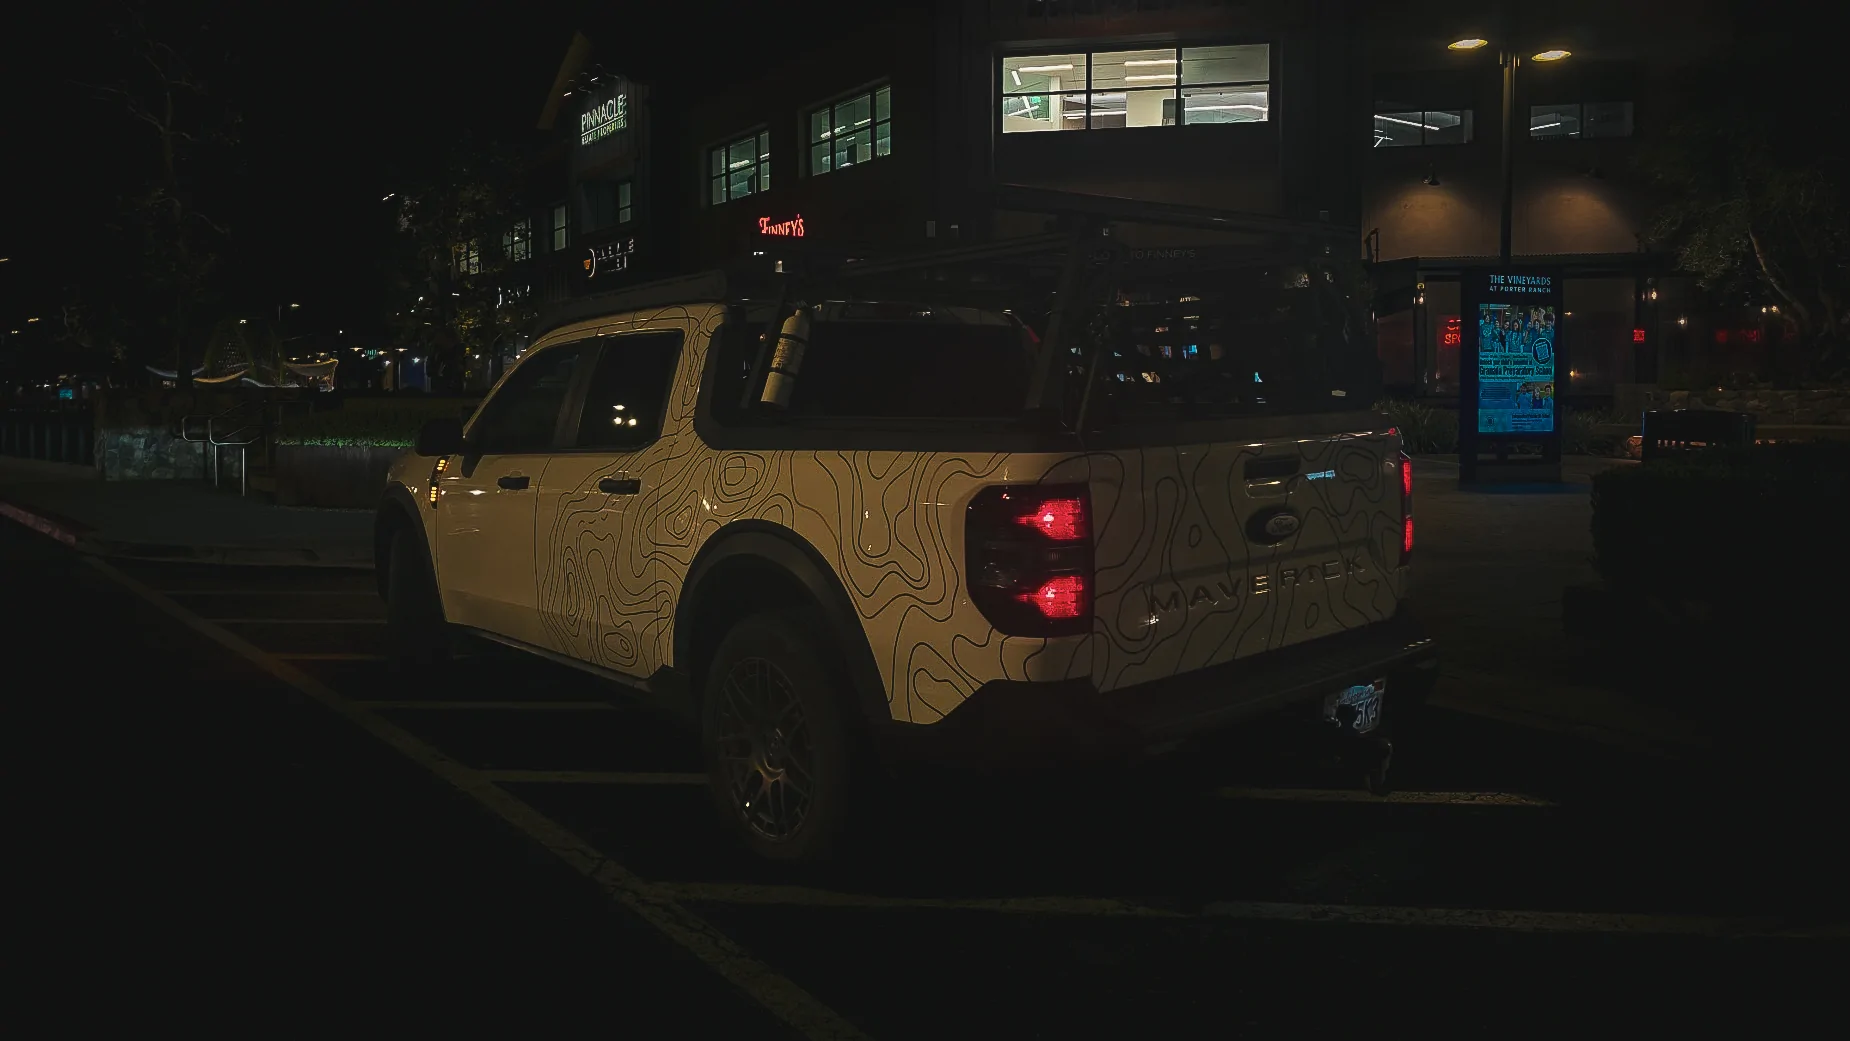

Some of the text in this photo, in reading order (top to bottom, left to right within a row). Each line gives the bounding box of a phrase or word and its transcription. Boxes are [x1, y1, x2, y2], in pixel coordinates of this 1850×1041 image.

[581, 93, 627, 133] PINNACLE
[1489, 275, 1551, 286] THE VINEYARDS
[1151, 556, 1367, 612] MAVERICK
